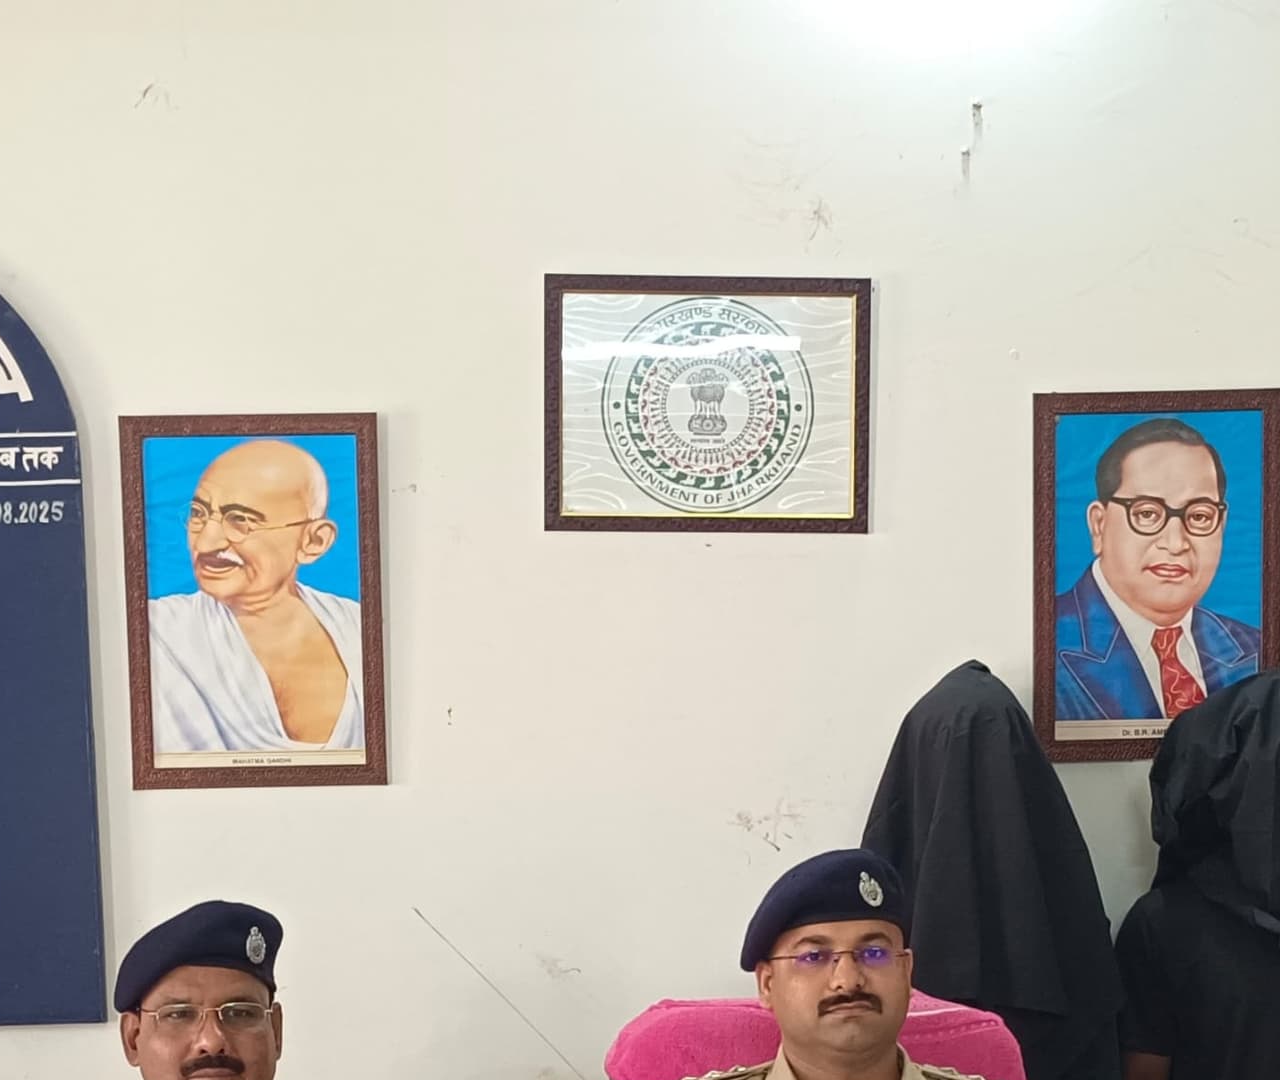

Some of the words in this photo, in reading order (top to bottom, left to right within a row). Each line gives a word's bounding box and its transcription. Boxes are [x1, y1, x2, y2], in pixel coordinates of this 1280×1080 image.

[21, 446, 64, 472] तक
[613, 420, 699, 504] GOVERNMENT
[704, 493, 723, 504] OF
[727, 423, 801, 502] JHARKHAND
